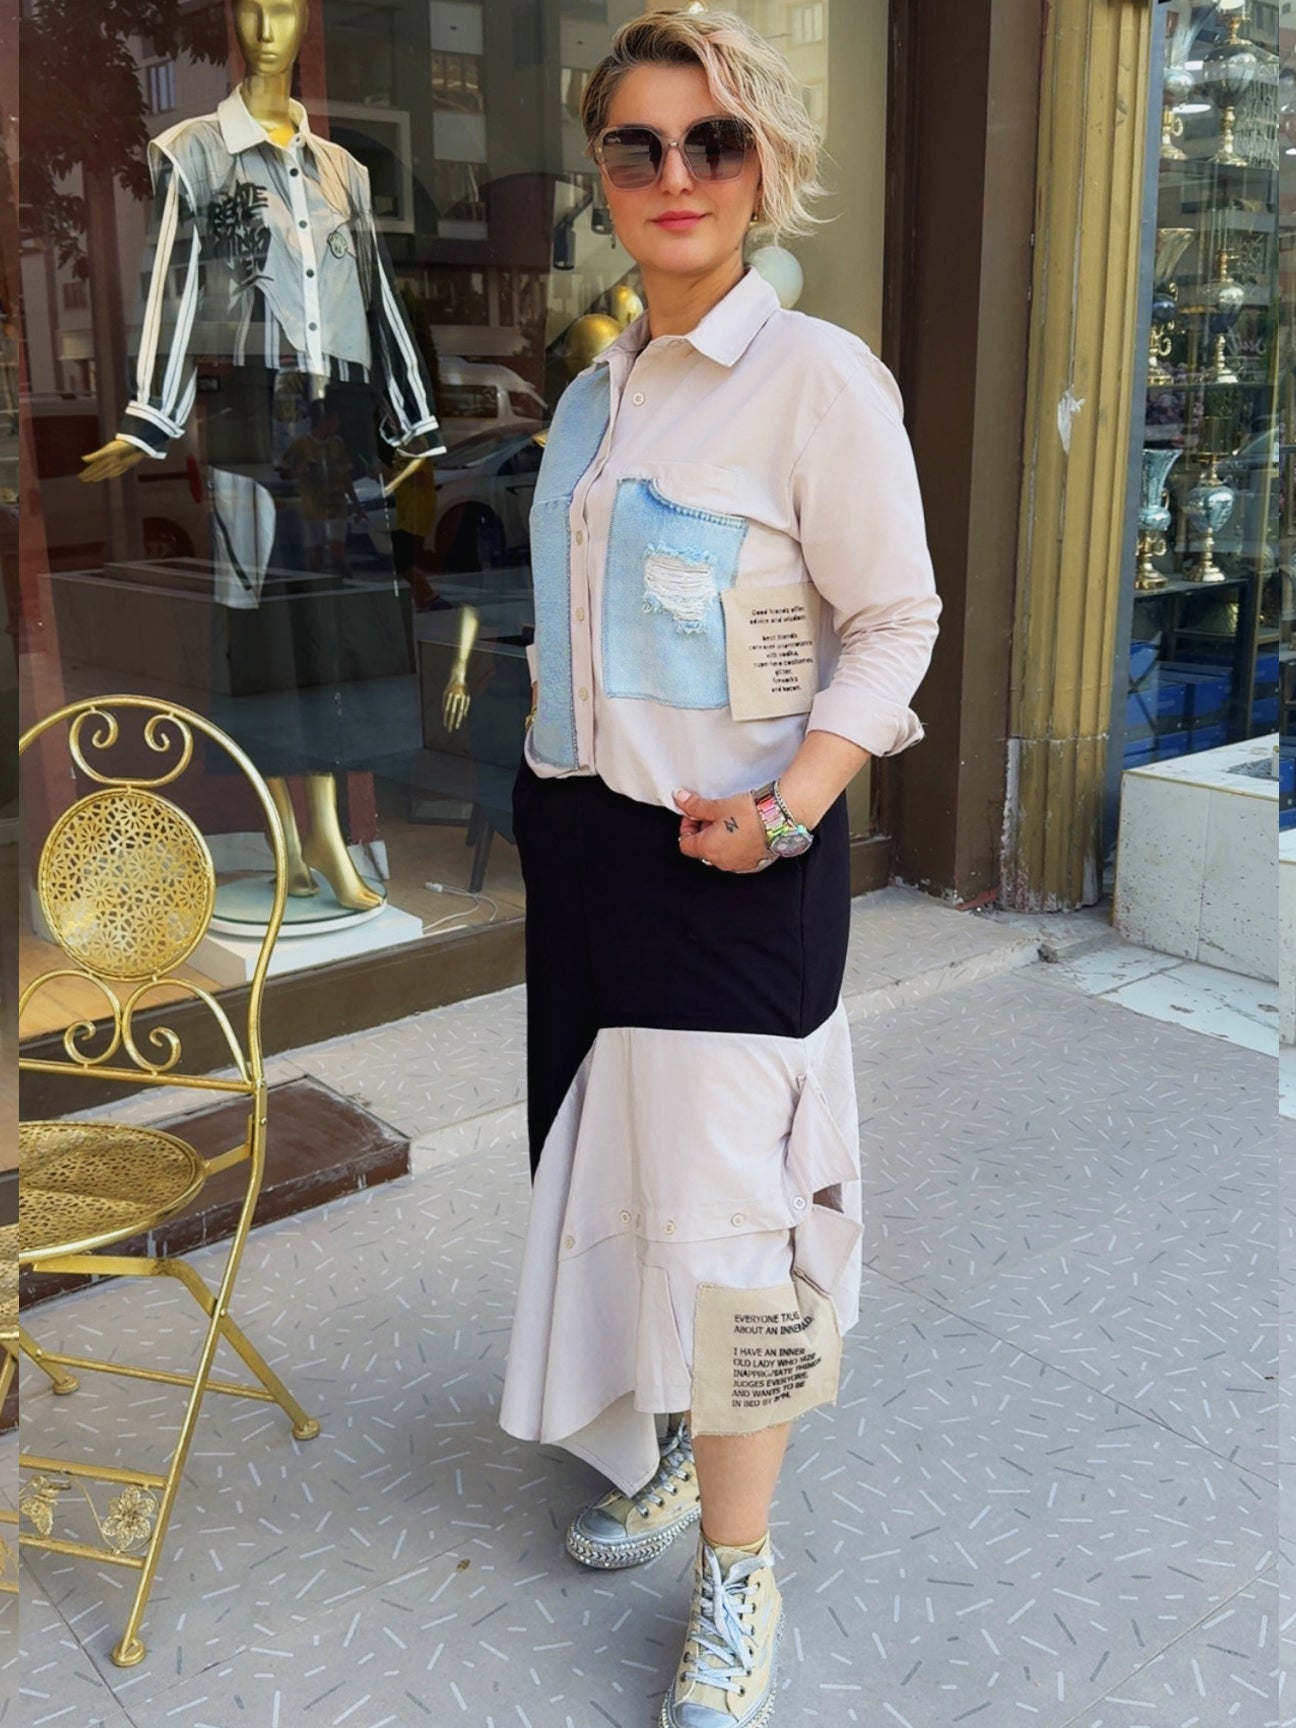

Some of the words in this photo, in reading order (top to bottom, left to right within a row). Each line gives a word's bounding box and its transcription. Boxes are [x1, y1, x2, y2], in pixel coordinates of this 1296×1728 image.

[734, 1314, 779, 1323] EVERYONE
[734, 1325, 763, 1334] ABOUT
[765, 1327, 777, 1335] AN
[740, 1348, 762, 1356] HAVE
[765, 1348, 777, 1356] AN
[779, 1348, 806, 1356] INNER
[733, 1358, 751, 1367] OLD
[753, 1360, 775, 1368] LADY
[777, 1359, 798, 1367] WHO
[733, 1380, 764, 1388] JUDGES
[732, 1389, 750, 1397] AND
[752, 1387, 781, 1397] WANTS
[783, 1383, 794, 1391] TO
